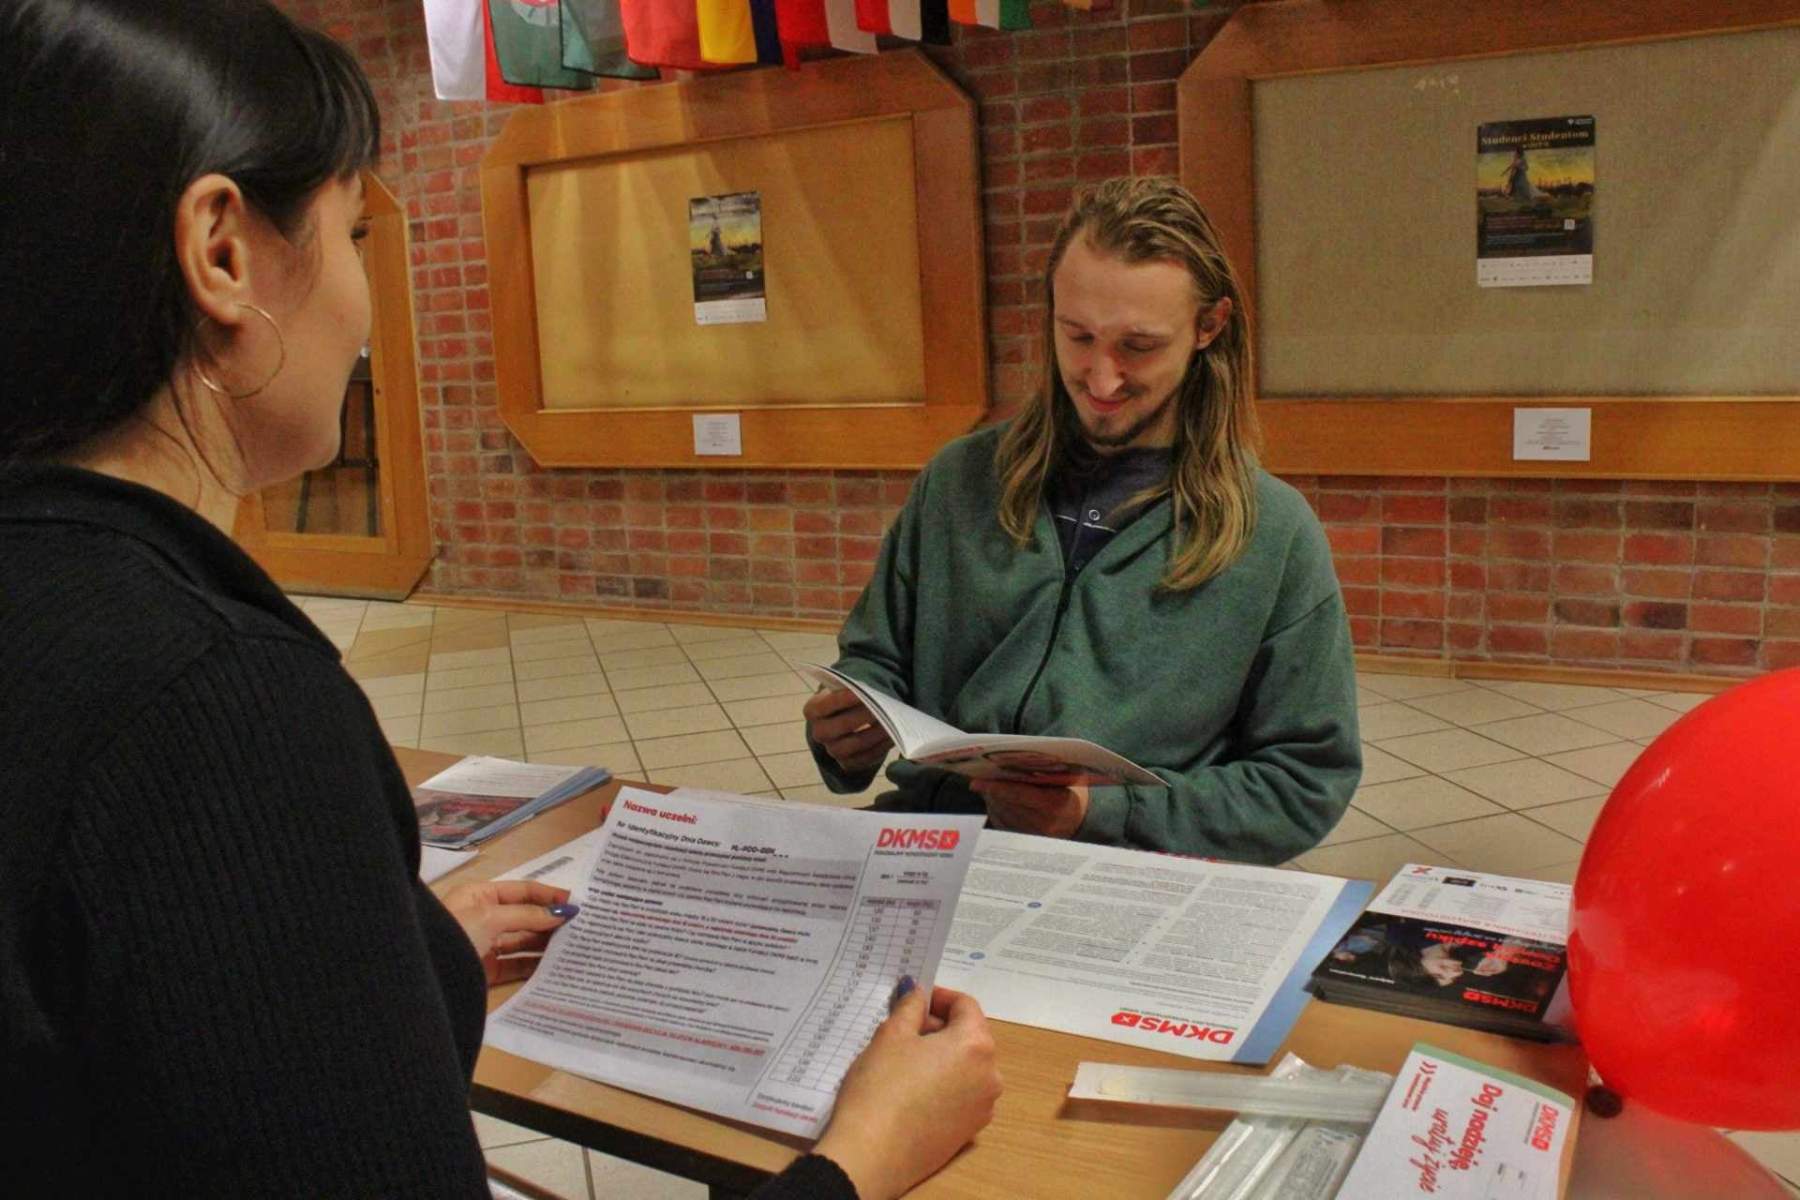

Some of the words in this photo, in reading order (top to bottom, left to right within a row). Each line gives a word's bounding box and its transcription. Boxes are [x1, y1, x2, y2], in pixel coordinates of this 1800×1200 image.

[623, 800, 657, 817] Nazwa
[659, 810, 698, 825] uczelni:
[876, 827, 941, 850] DKMS
[1138, 1016, 1235, 1045] DKMS
[1470, 1083, 1503, 1112] Daj
[1411, 1107, 1456, 1155] uratuj
[1409, 1152, 1446, 1193] życie
